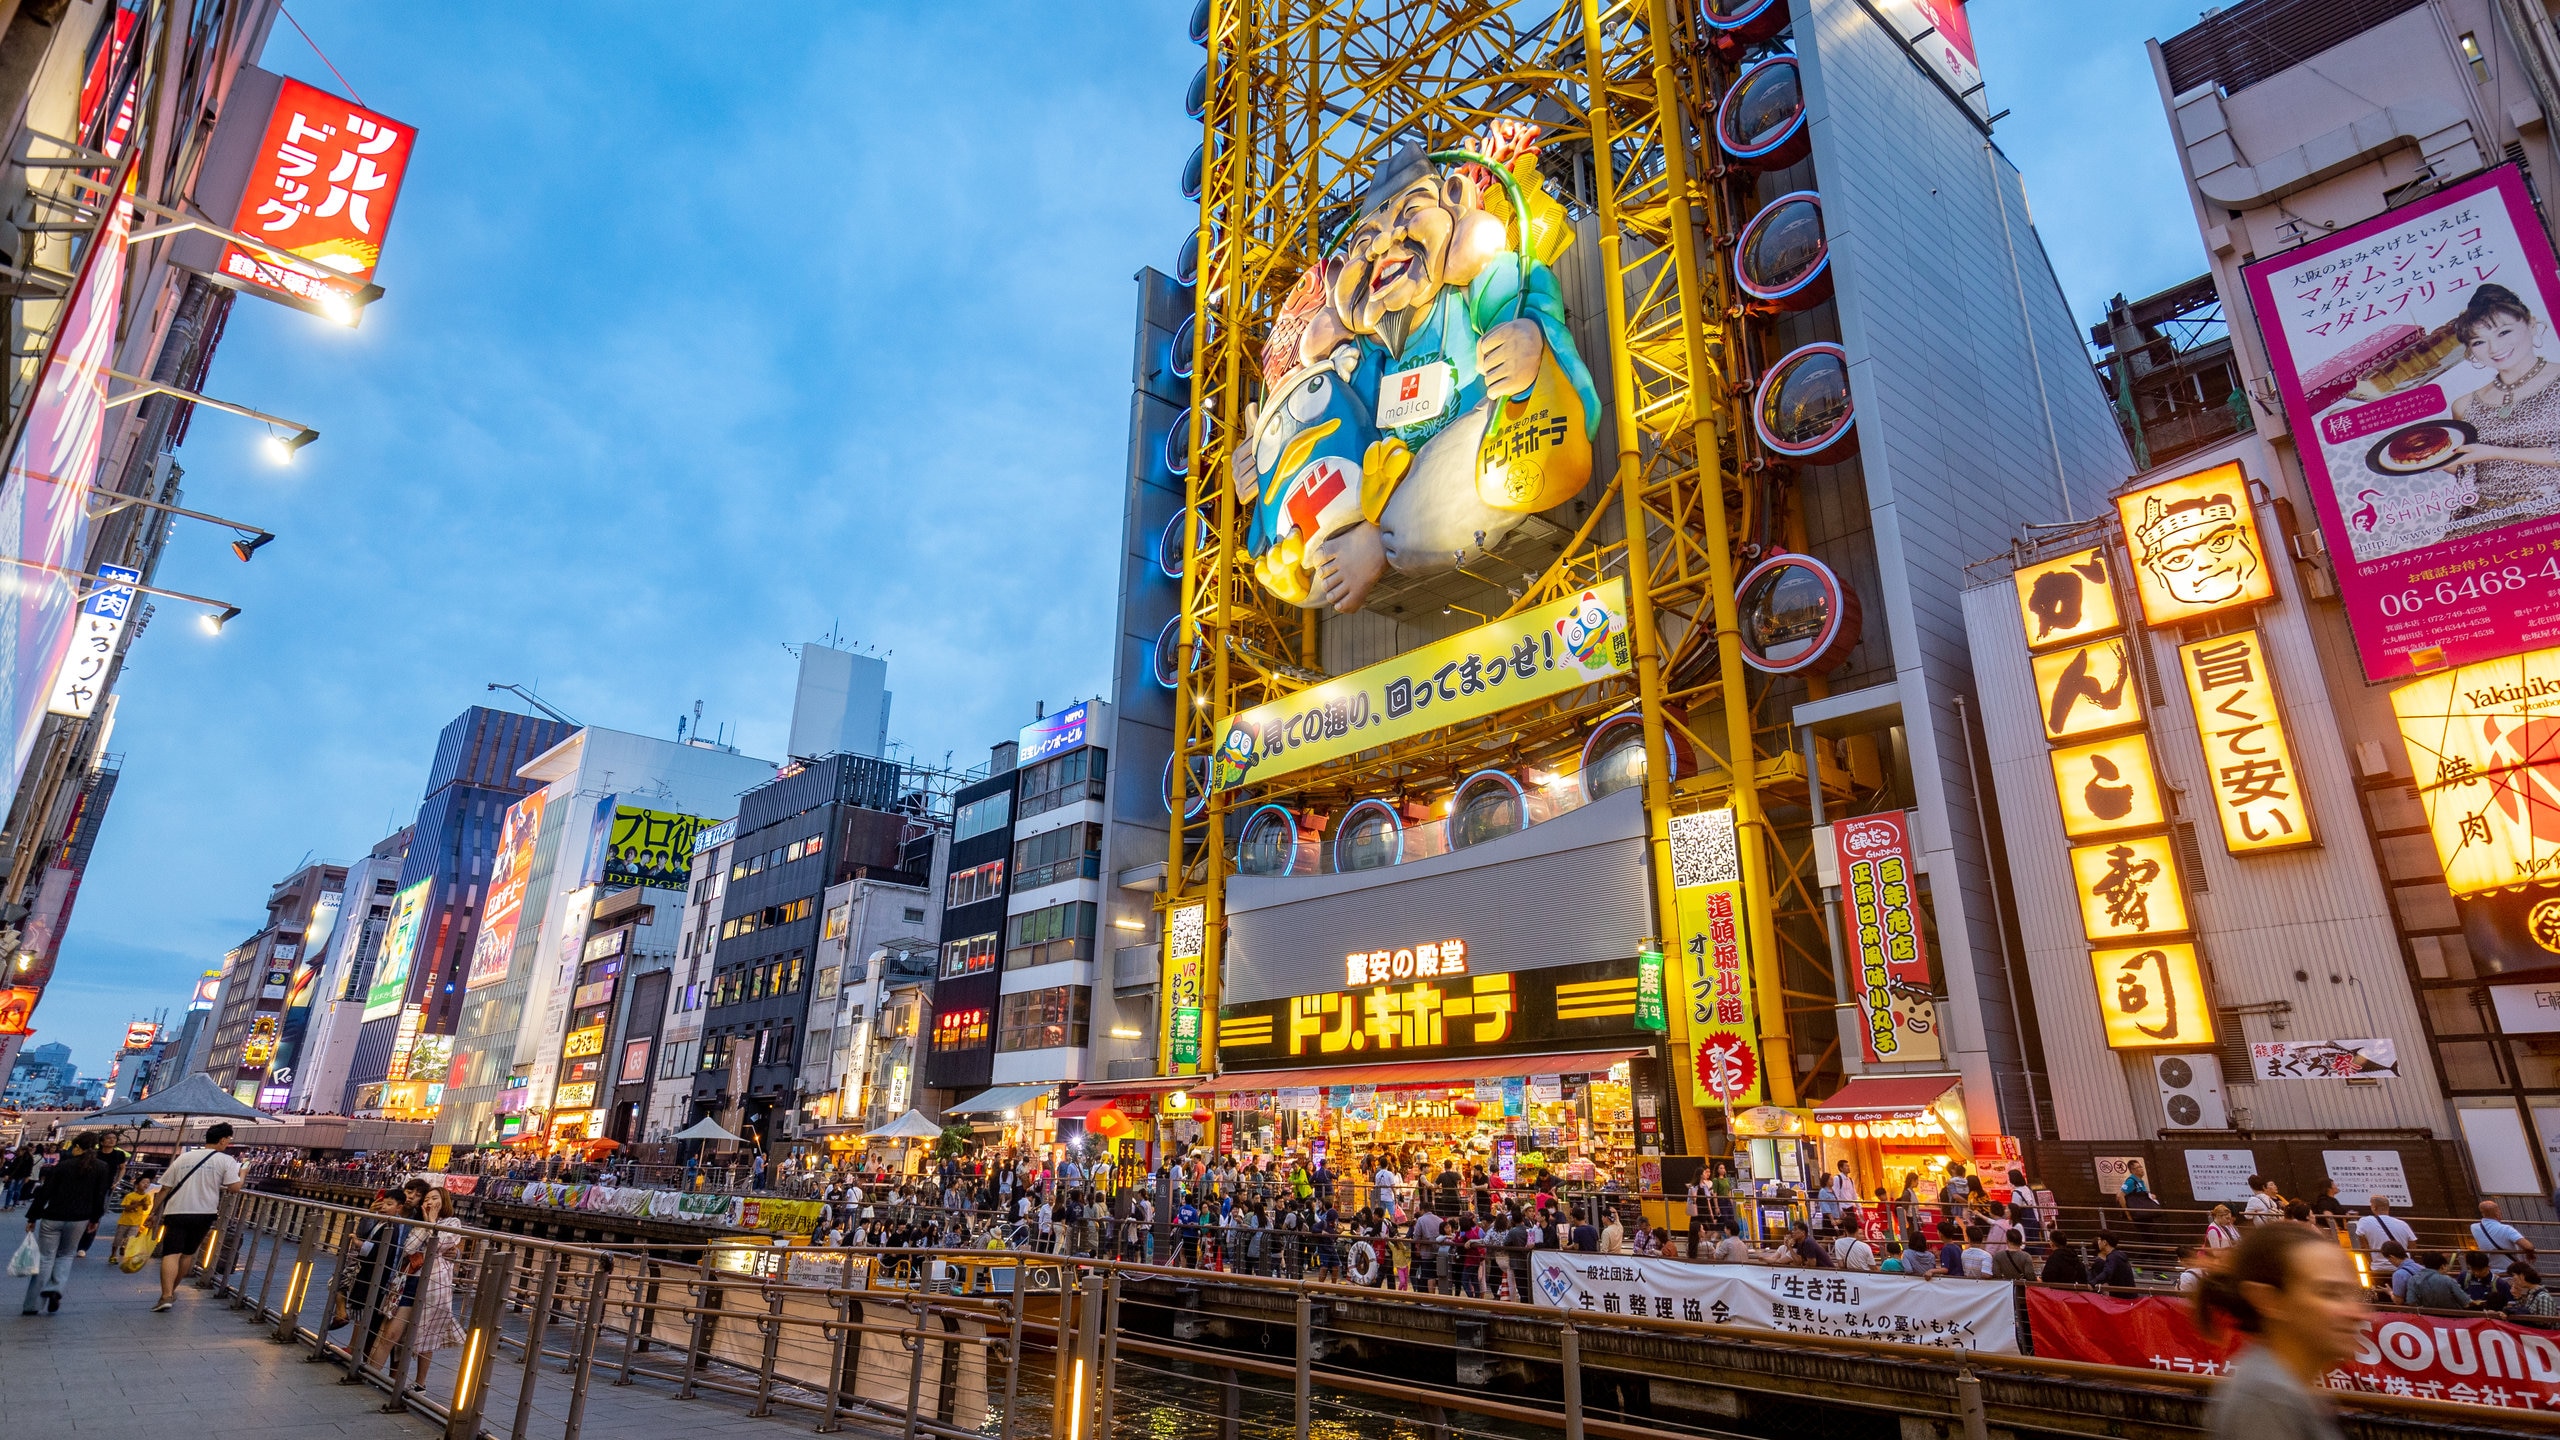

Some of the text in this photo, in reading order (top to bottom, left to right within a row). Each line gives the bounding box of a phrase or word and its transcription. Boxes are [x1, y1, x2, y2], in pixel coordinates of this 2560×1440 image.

[256, 112, 337, 231] ドラッグ
[315, 113, 398, 235] ツルハ
[2297, 227, 2483, 303] マダムシンコ
[2302, 245, 2494, 319] マダムシンコといえば、
[2306, 263, 2500, 337] マダムブリュレ
[2328, 415, 2353, 436] 棒
[2382, 480, 2474, 513] MADAME
[2385, 493, 2480, 525] SHINCO
[2358, 493, 2560, 553] http://www.cowcowfoodsyste
[66, 620, 116, 710] いろりや
[1613, 632, 1630, 669] 開運
[2464, 676, 2560, 710] Yakinik
[2193, 640, 2293, 842] 旨くて安い
[1849, 827, 1892, 850] 銀だこ
[1866, 847, 1902, 858] GINDACO
[608, 873, 656, 887] DEEP
[1880, 858, 1916, 962] 百年老店
[1183, 963, 1196, 977] VR
[1347, 939, 1467, 985] 驚安の殿堂
[1705, 891, 1745, 1025] 道頓堀北館
[1851, 863, 1897, 1053] 正宗日本風味小丸子
[1640, 963, 1660, 995] 薬
[1688, 933, 1714, 1025] オープン
[1177, 1015, 1197, 1038] 薬
[2254, 1044, 2286, 1058] 熊野
[1816, 1113, 1843, 1122] GINDACO
[1854, 1113, 1882, 1121] GINDACO
[1576, 1265, 1647, 1283] 一般社団法人
[1578, 1290, 1731, 1324] 生前整理協会
[1772, 1303, 1975, 1336] 整理をし、なんの憂いもなく
